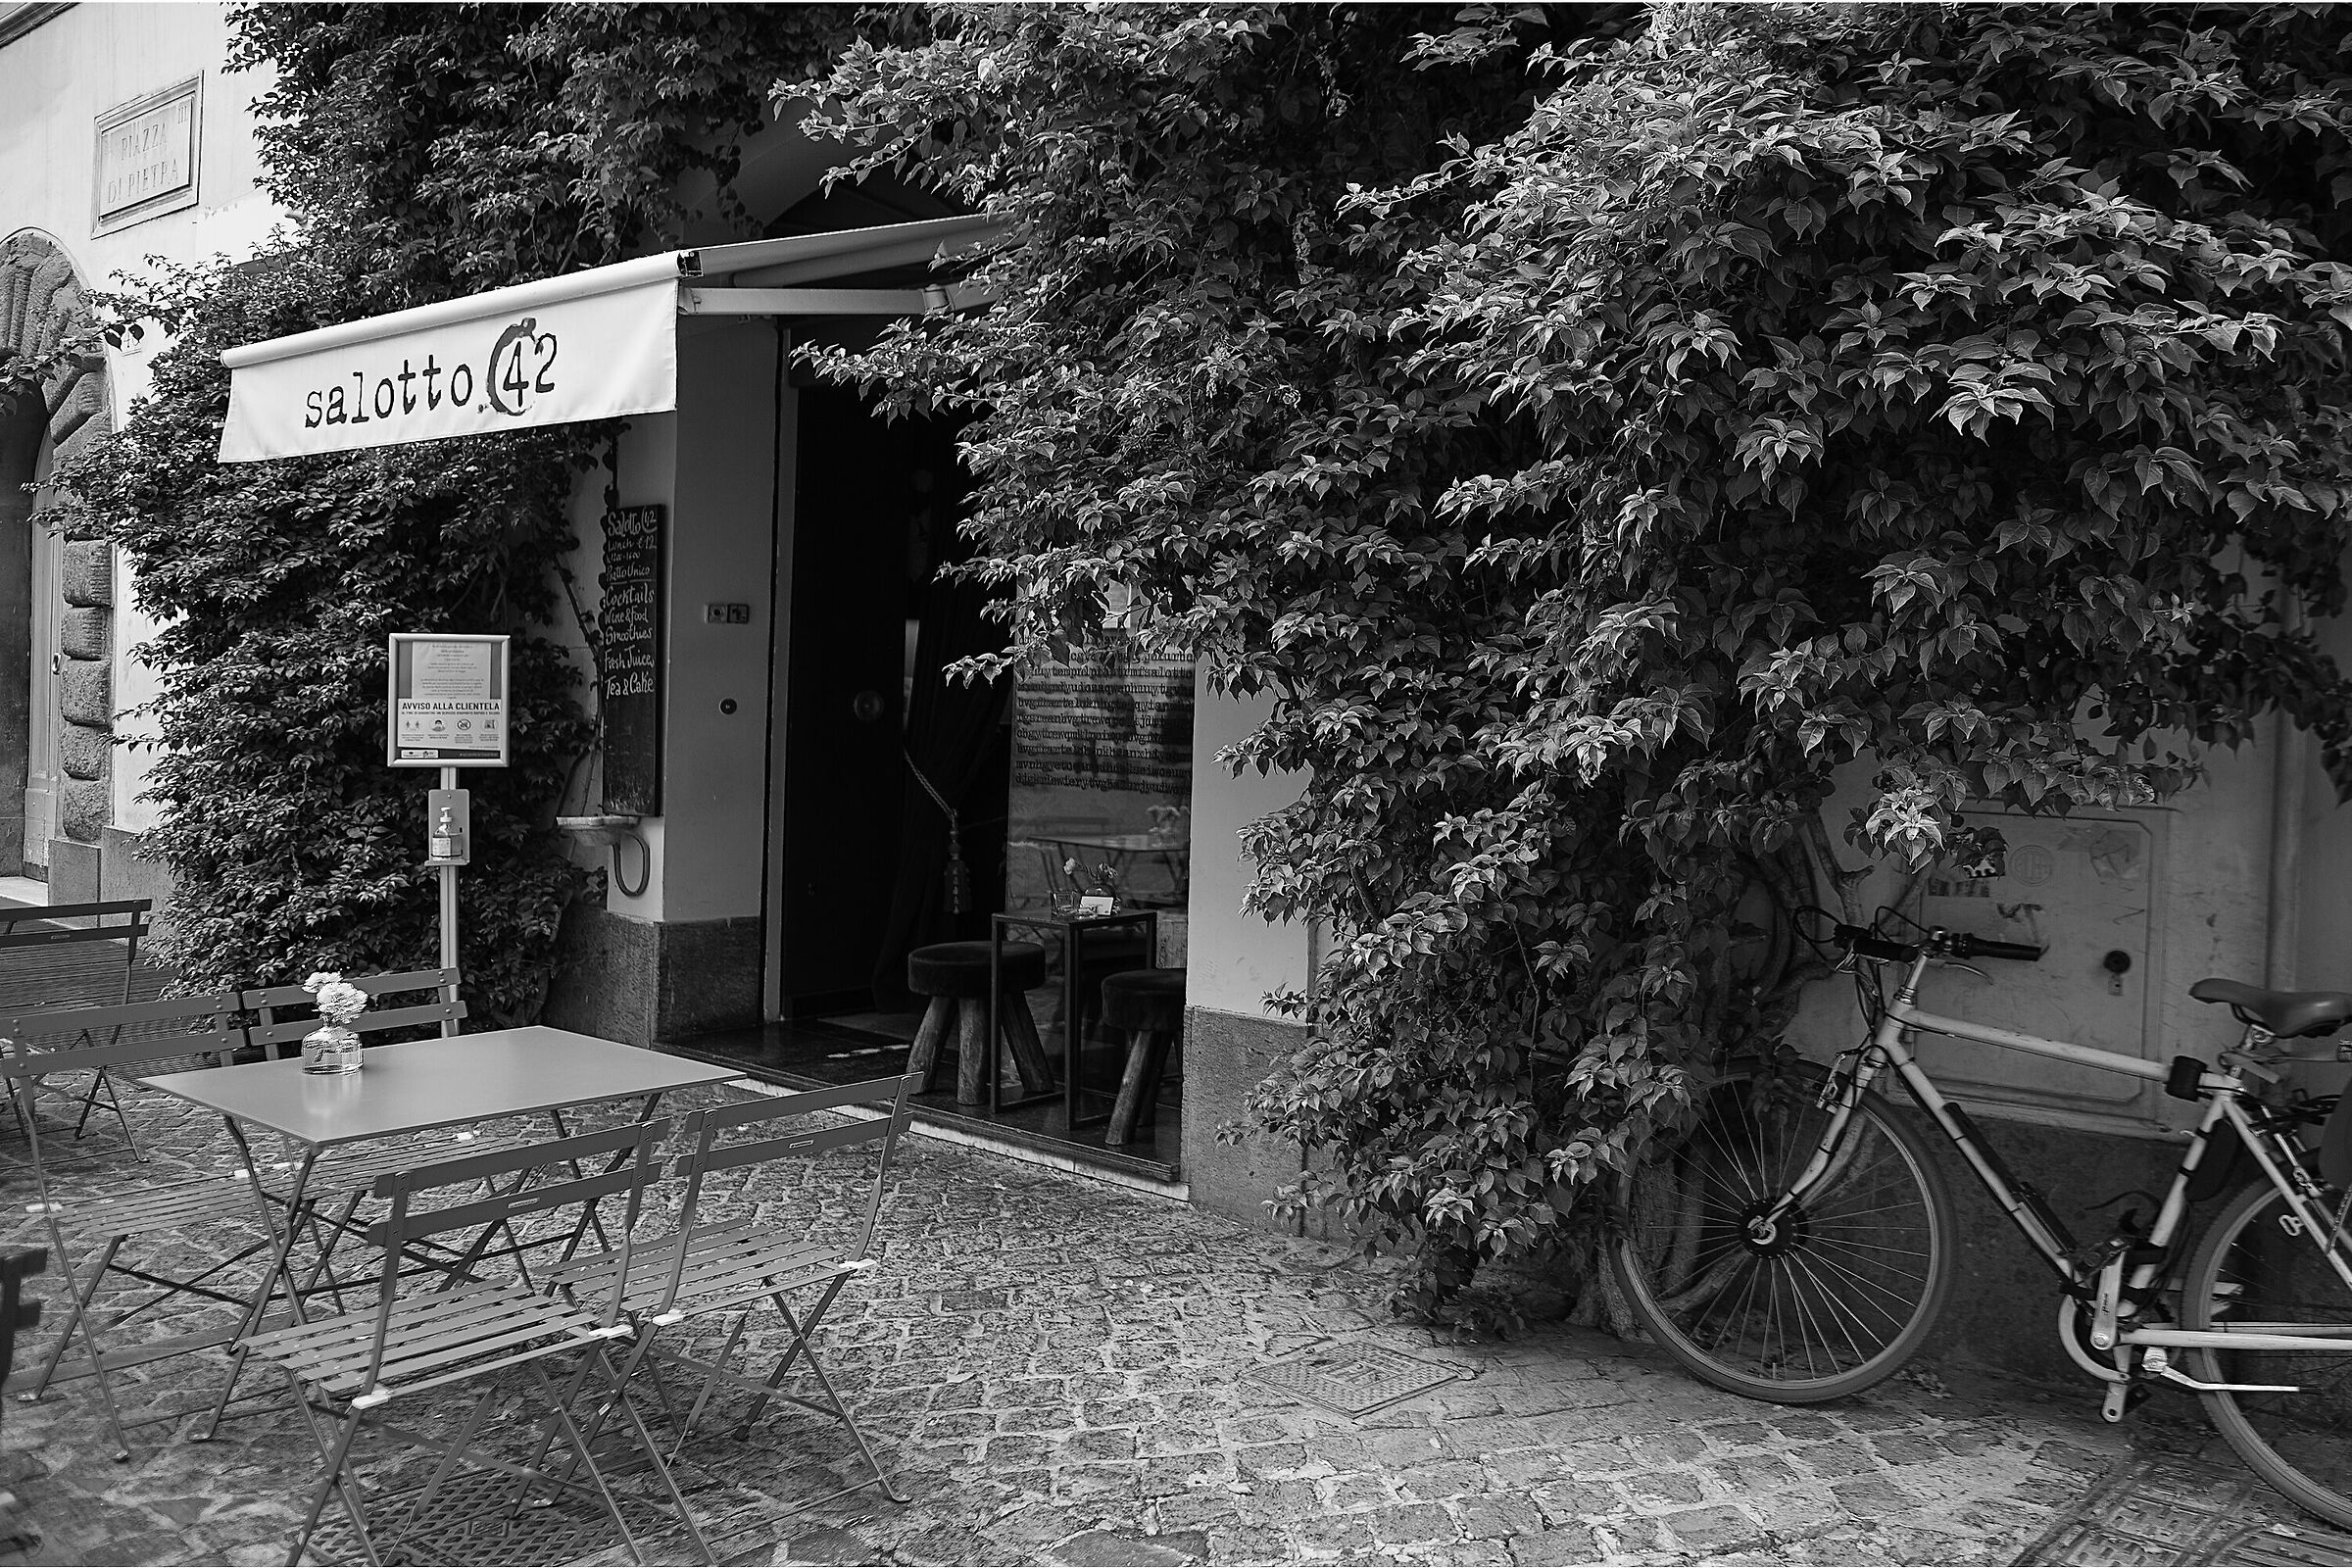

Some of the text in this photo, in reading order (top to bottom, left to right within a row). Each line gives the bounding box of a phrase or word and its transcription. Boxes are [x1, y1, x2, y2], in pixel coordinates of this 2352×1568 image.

[122, 122, 168, 161] PIAZZA
[108, 158, 178, 204] DI PIETRA
[305, 328, 558, 428] salotto 42
[608, 511, 641, 537] Salotto
[608, 538, 634, 552] Lunch
[627, 561, 651, 577] Unico
[606, 583, 655, 607] Cocktails
[605, 624, 653, 645] Smoothies
[605, 648, 625, 673] Fresh
[605, 674, 621, 700] Tea
[629, 670, 655, 694] Cake
[402, 702, 500, 710] AVVISO ALLA CLIENTELA
